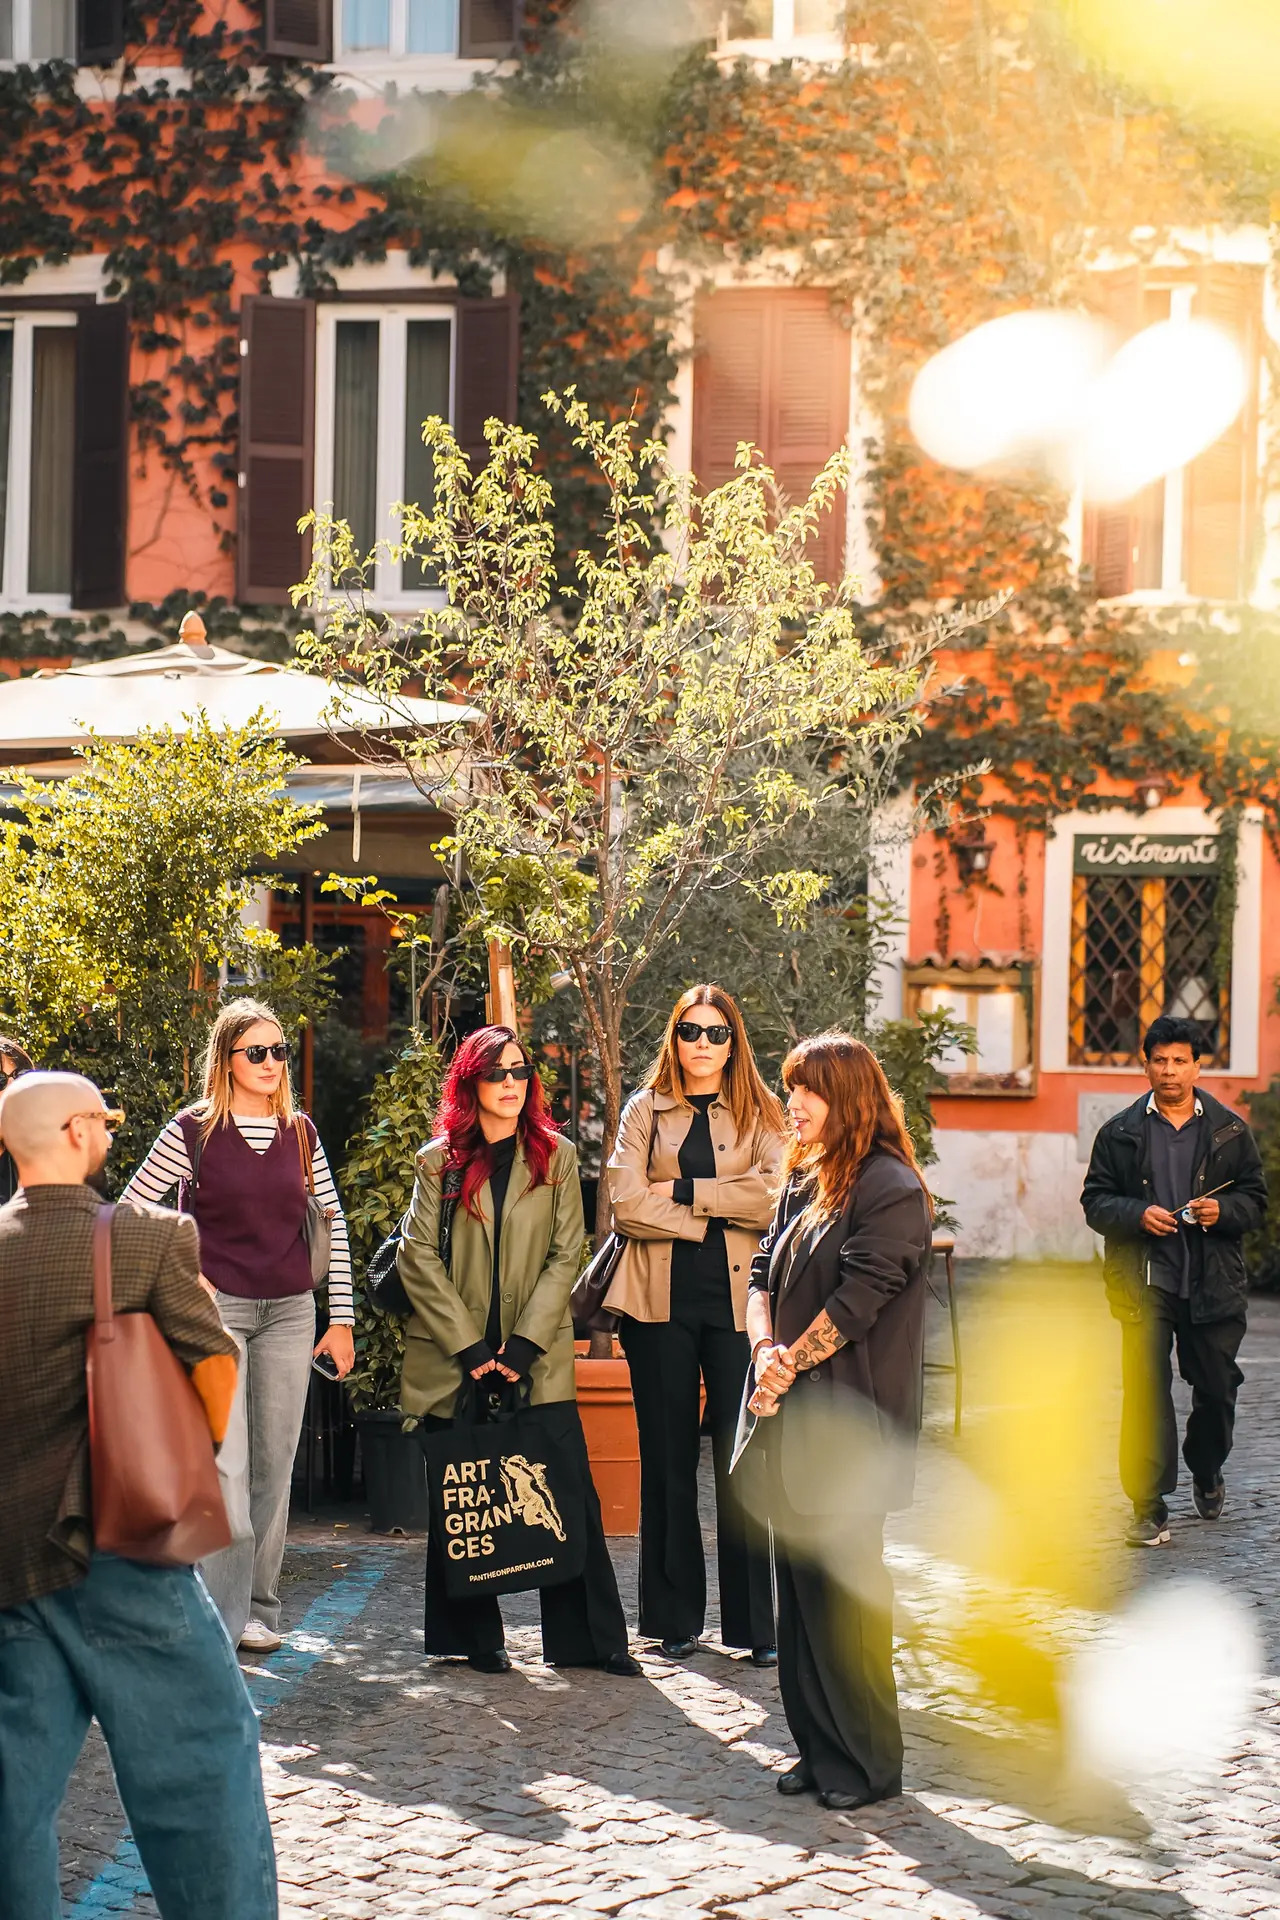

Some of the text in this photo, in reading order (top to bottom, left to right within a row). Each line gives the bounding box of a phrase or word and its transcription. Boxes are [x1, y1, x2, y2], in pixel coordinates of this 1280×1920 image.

[443, 1459, 491, 1486] ART
[447, 1534, 496, 1561] CES
[469, 1557, 554, 1582] PANTHEONPARFUM.COM
